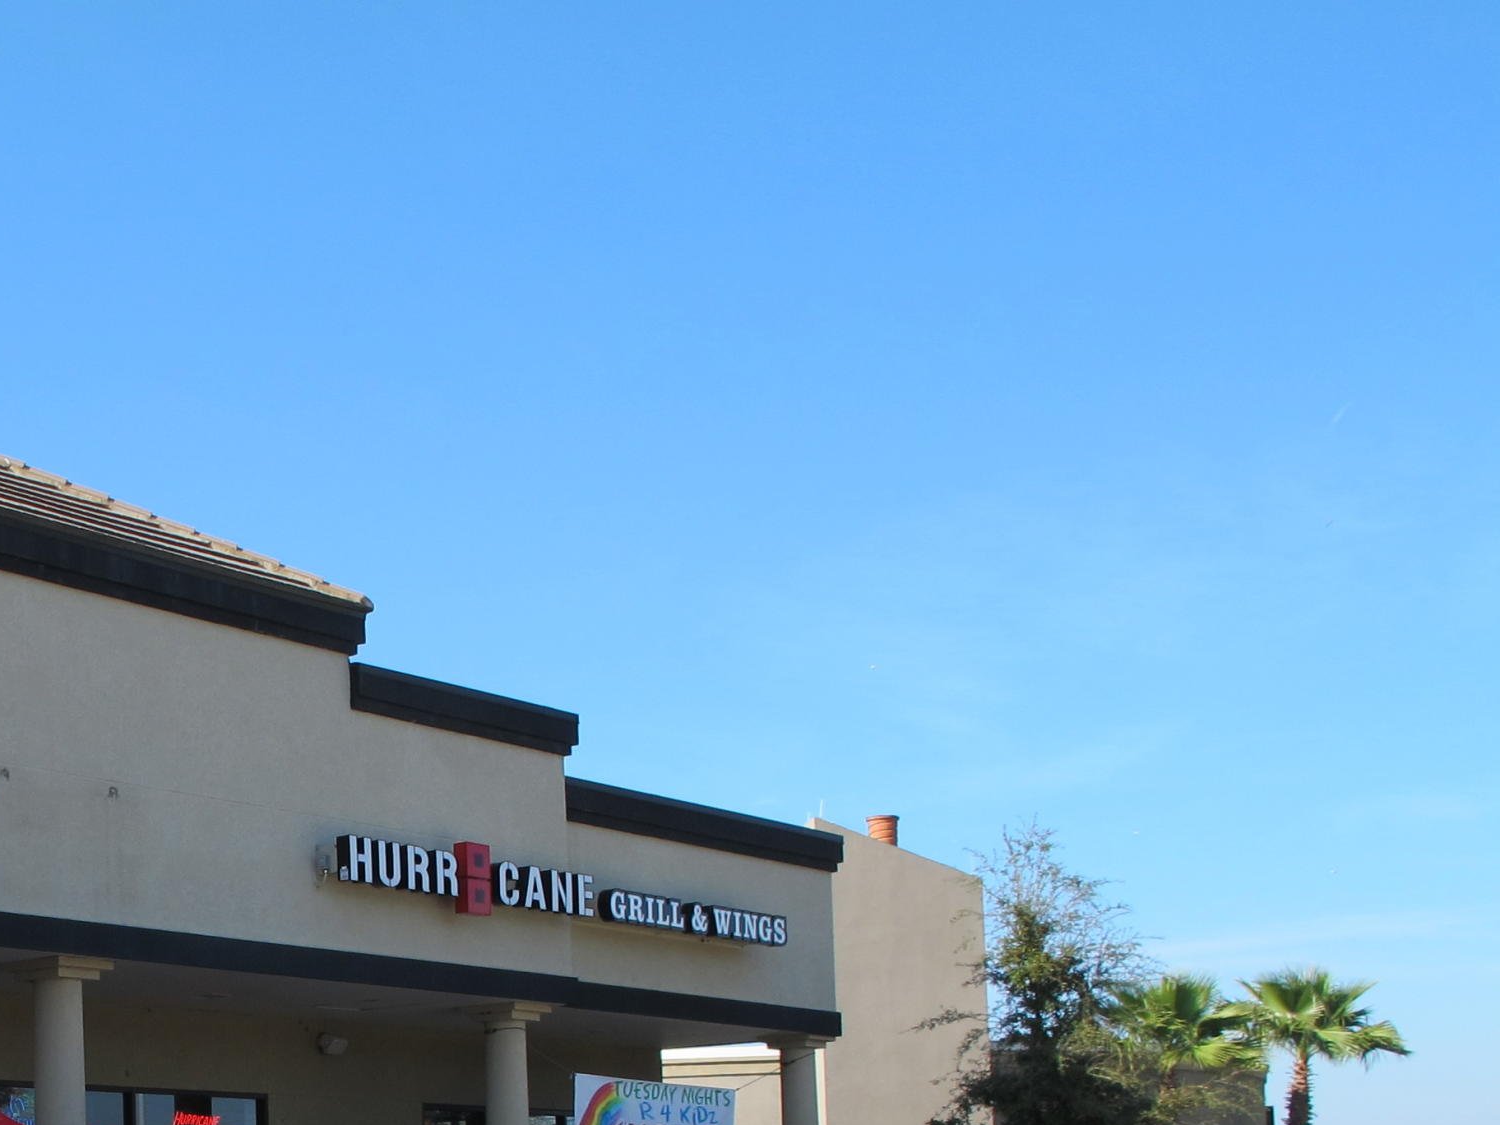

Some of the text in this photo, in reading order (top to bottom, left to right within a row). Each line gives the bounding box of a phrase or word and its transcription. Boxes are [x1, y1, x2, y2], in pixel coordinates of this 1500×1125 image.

[609, 890, 787, 945] GRILL & WINGS
[614, 1080, 731, 1107] TUESDAY NIGHTS
[639, 1101, 654, 1120] R
[660, 1104, 672, 1123] 4
